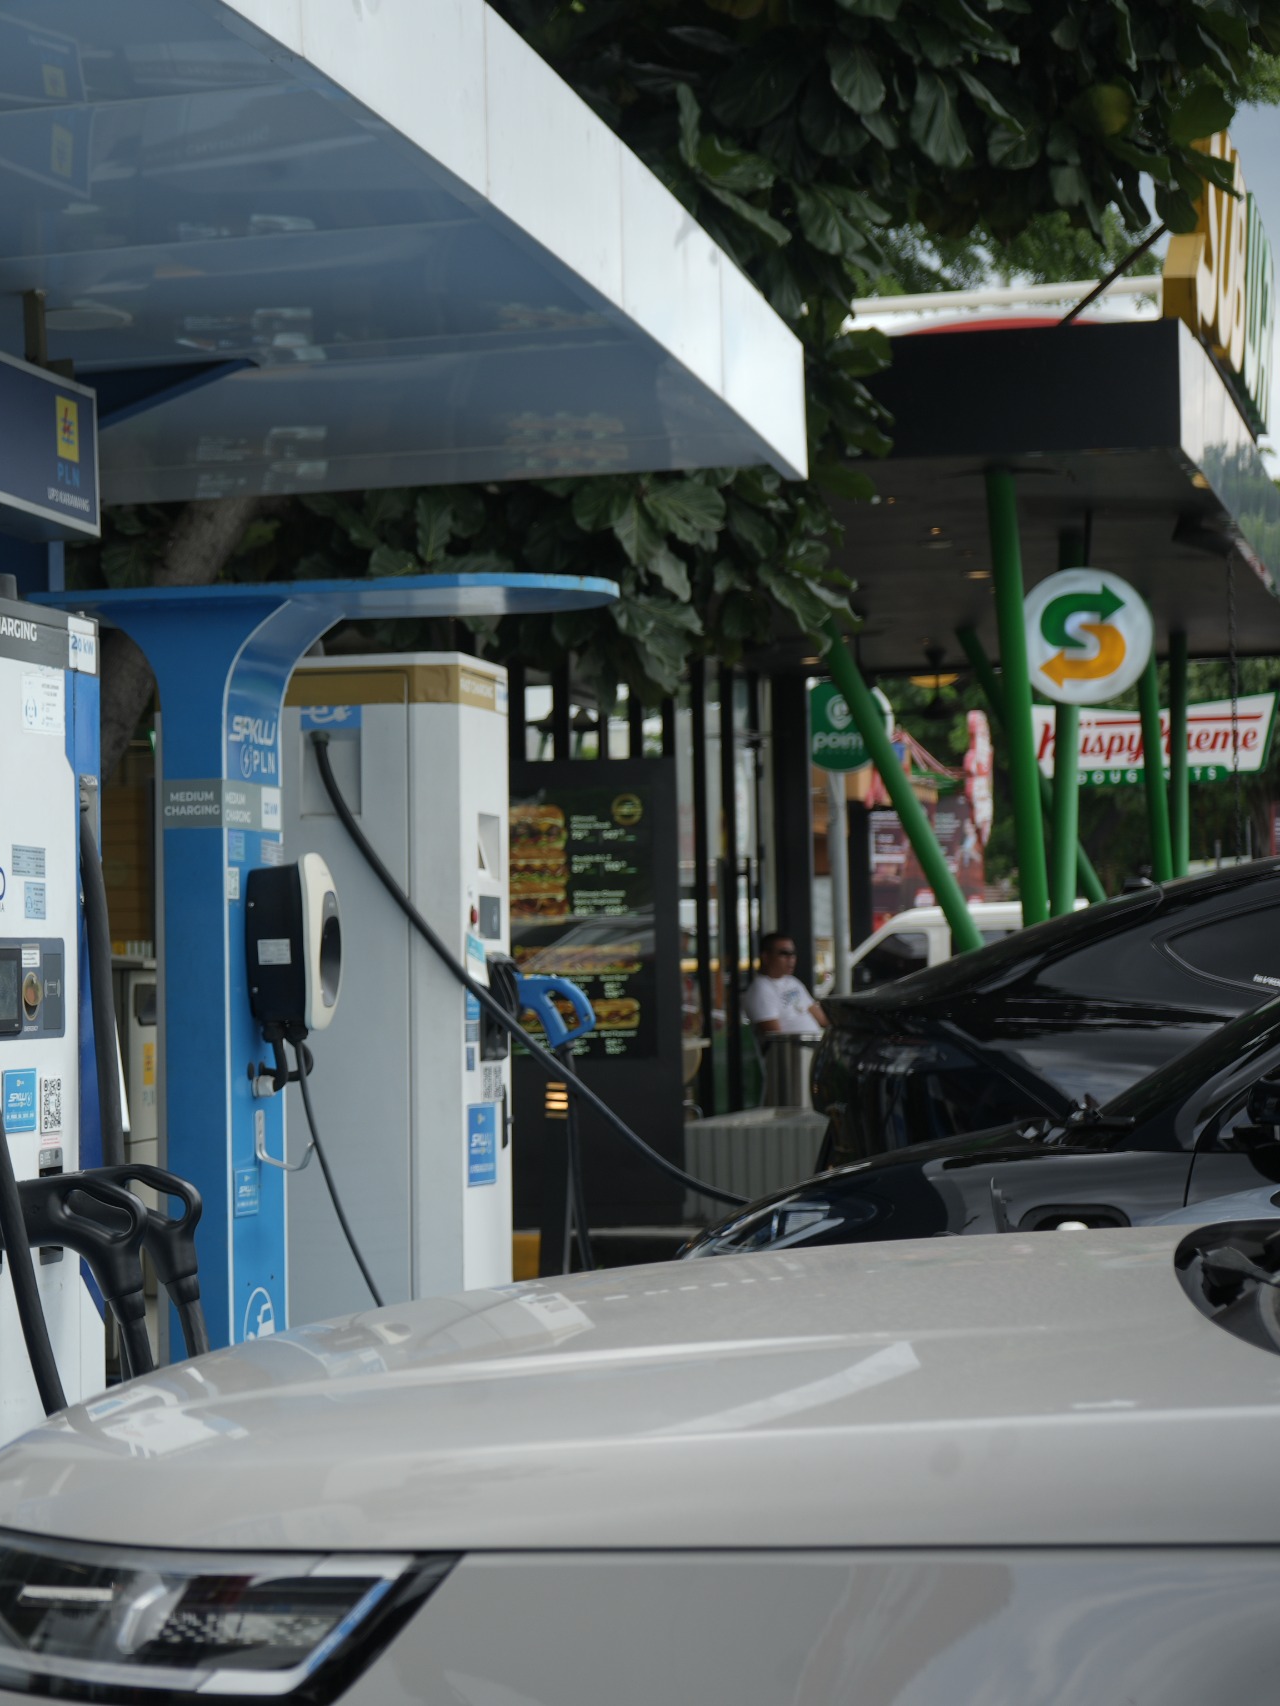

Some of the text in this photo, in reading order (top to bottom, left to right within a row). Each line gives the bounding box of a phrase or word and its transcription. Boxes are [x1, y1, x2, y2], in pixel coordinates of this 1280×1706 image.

[57, 461, 80, 488] PLN
[228, 715, 276, 746] SPKLU
[1038, 721, 1144, 763] Kispy
[253, 750, 275, 774] PLN
[170, 791, 214, 802] MEDIUM
[164, 804, 220, 816] CHARGING
